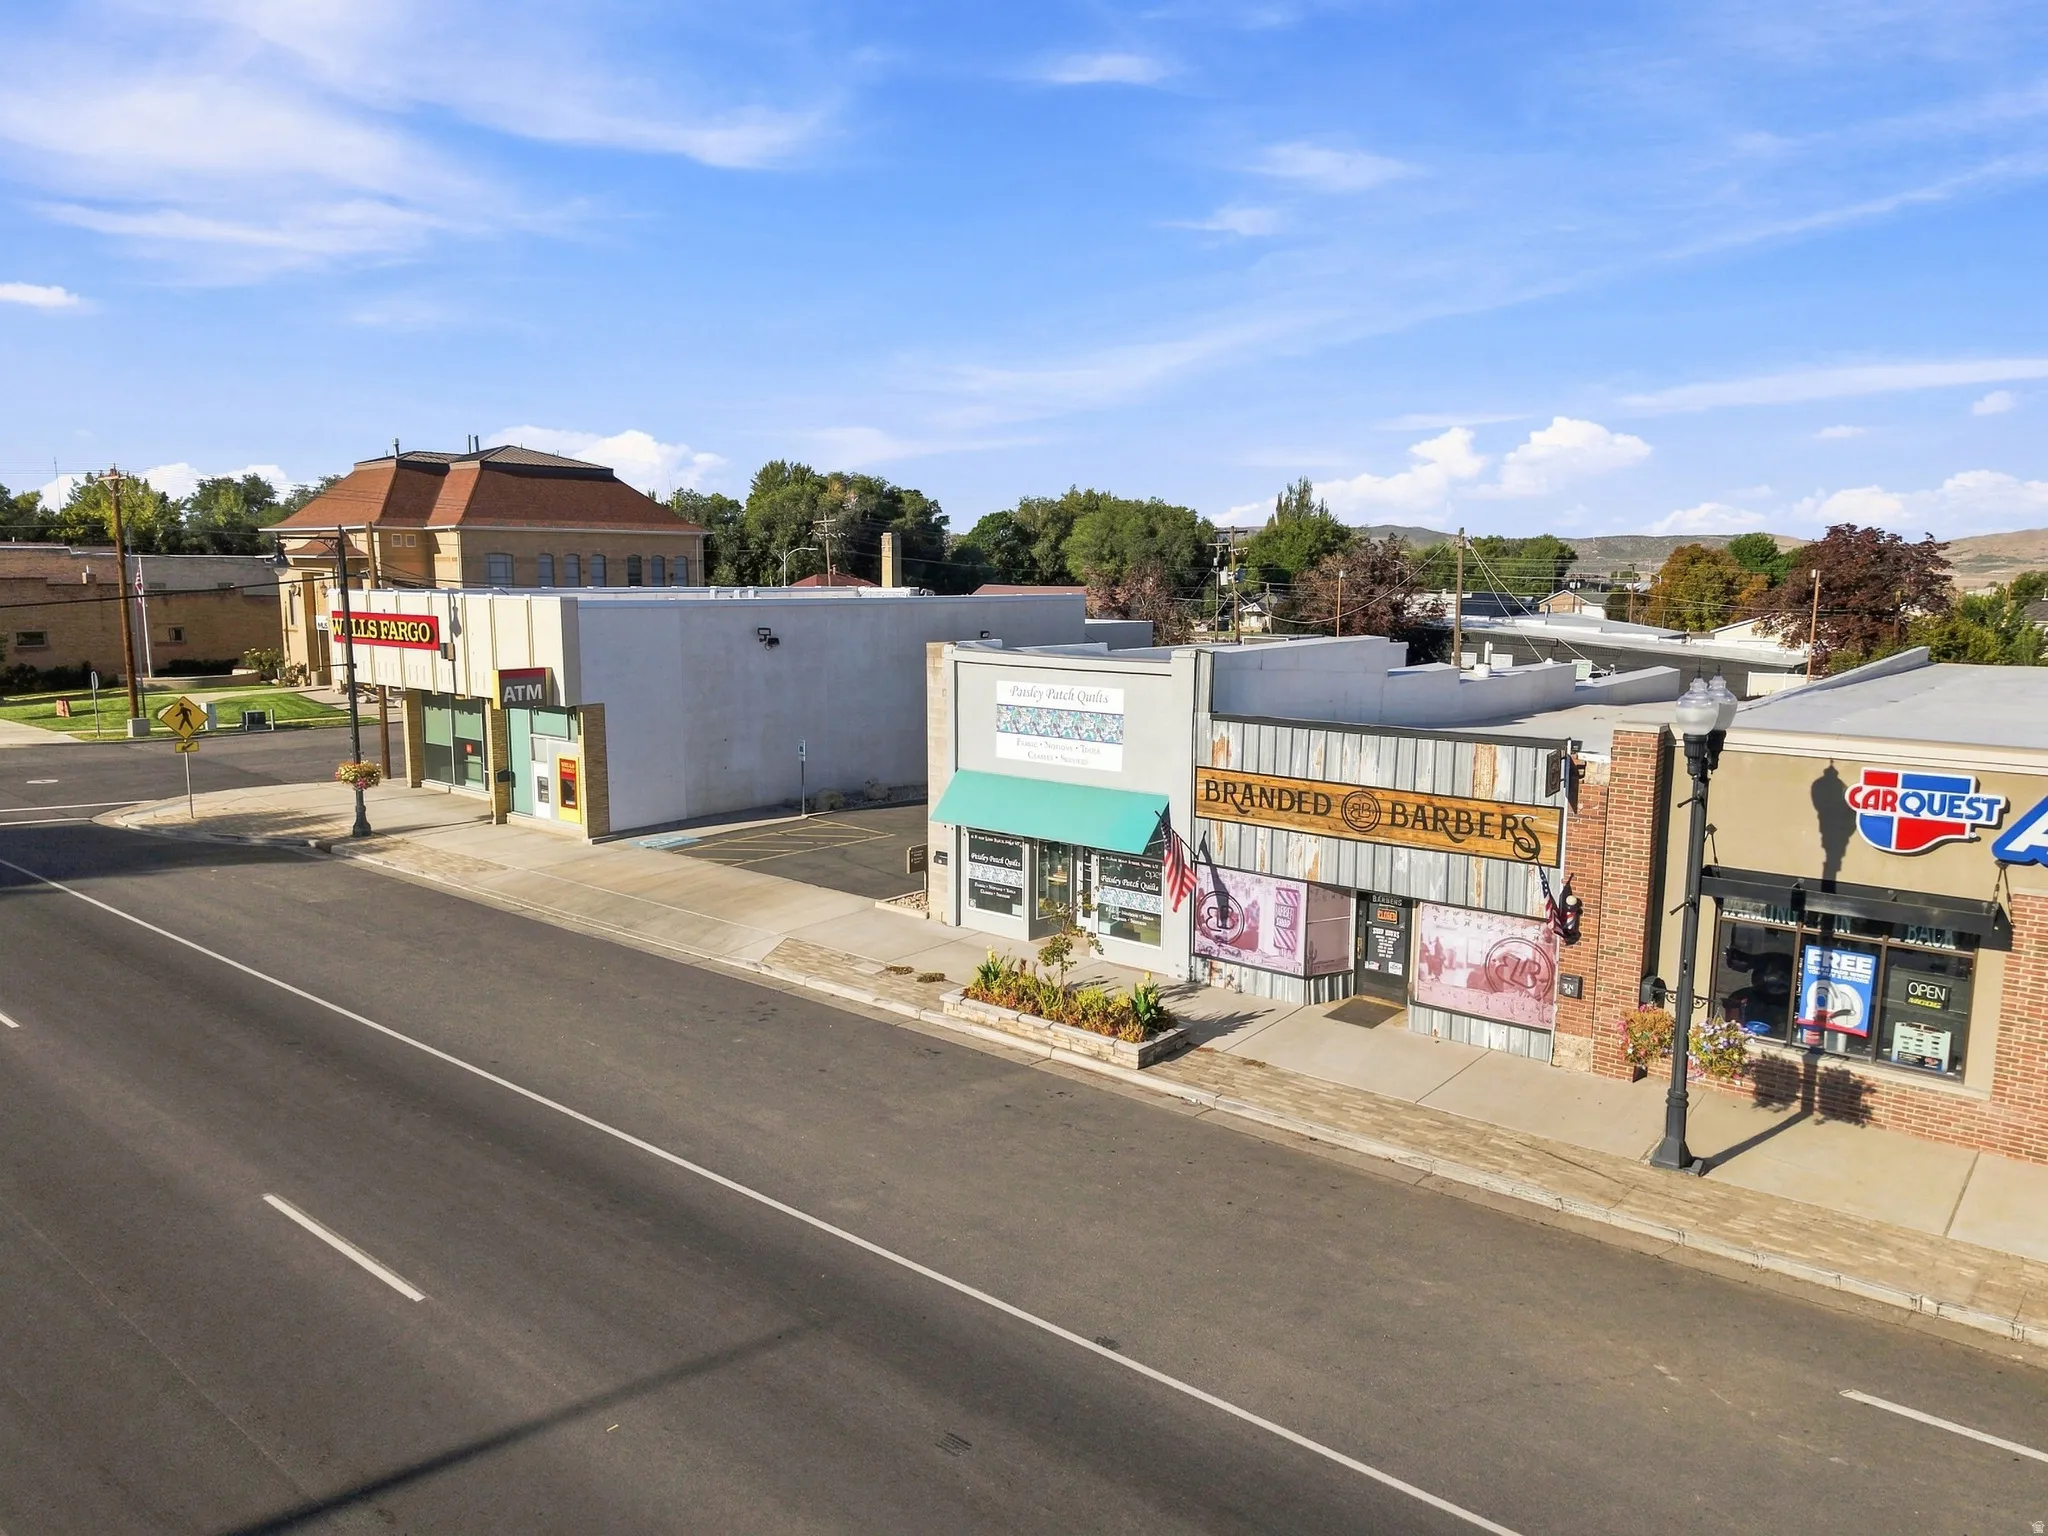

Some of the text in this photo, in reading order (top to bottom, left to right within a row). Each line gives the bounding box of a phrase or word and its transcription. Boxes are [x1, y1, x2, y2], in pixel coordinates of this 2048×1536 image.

[332, 618, 430, 642] WLLS FARGO
[503, 684, 542, 702] ATM
[1009, 685, 1109, 706] Paisley Patch Quilts
[1848, 786, 2001, 822] CARQUEST
[1205, 780, 1331, 815] BRANDED
[1389, 800, 1541, 861] BARBERS
[989, 855, 1004, 864] Patch
[1005, 858, 1021, 868] Quilts
[1100, 875, 1159, 892] Paisley Patch Quilts
[1372, 895, 1403, 906] BARBERS
[1377, 909, 1398, 922] CLOSED
[1807, 948, 1873, 971] FREE
[1908, 982, 1946, 1001] OPEN
